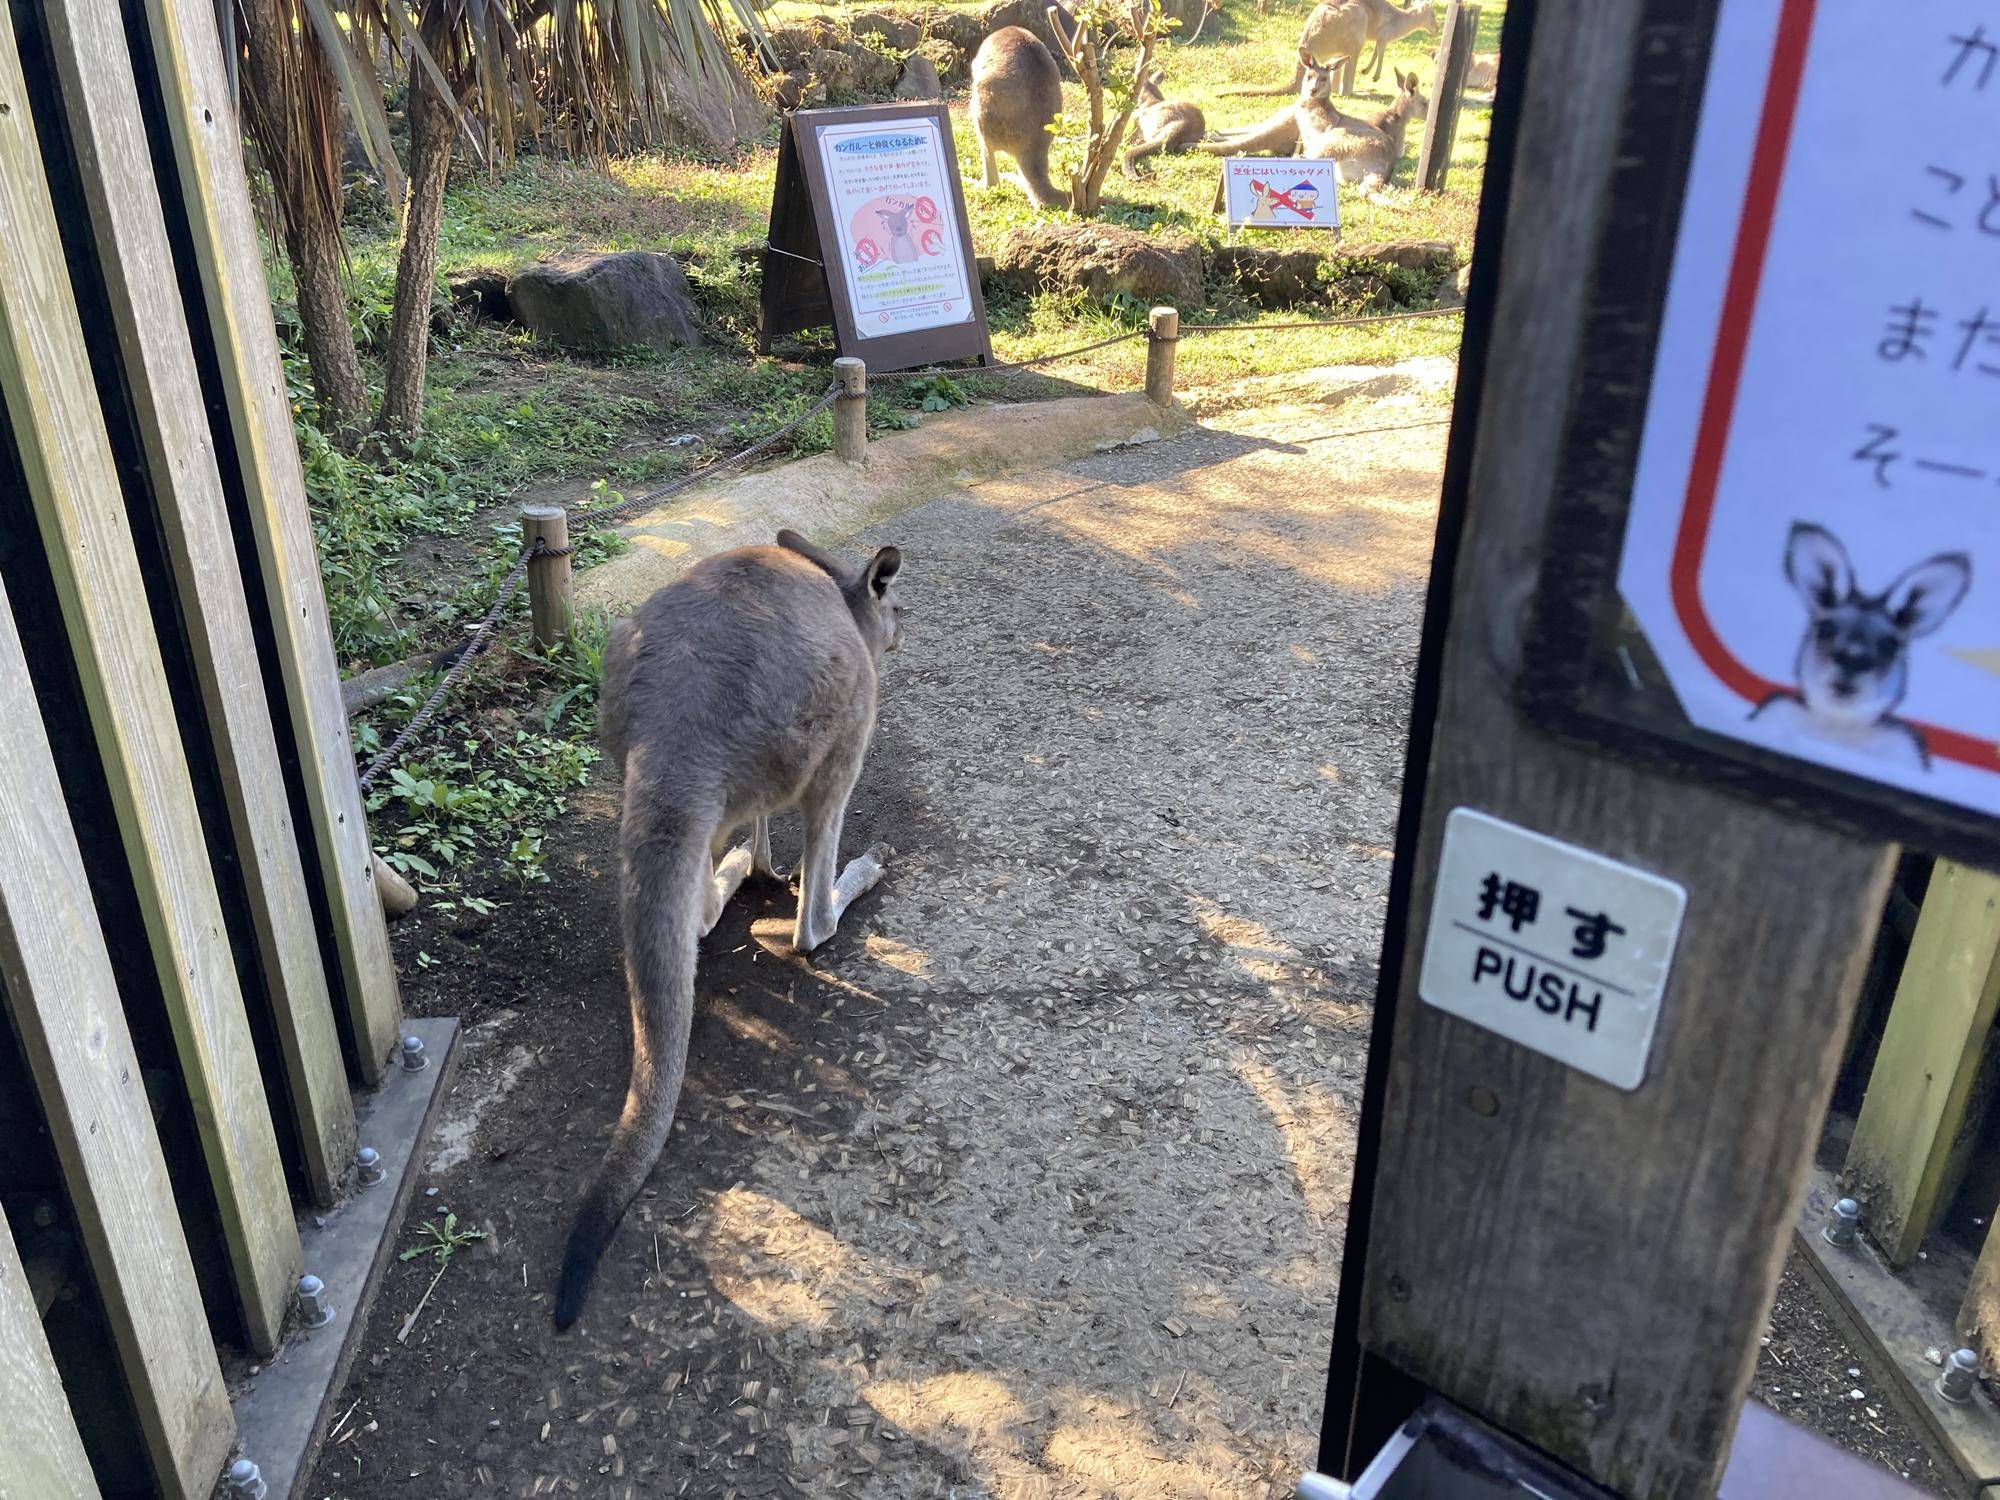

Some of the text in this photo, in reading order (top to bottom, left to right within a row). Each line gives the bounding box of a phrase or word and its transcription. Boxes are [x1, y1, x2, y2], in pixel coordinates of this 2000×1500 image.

[834, 136, 928, 153] カンガルーと仲良くなるために
[1876, 297, 2000, 376] また
[1851, 422, 2000, 491] そー
[1477, 872, 1627, 960] 押す
[1472, 947, 1603, 1033] PUSH
